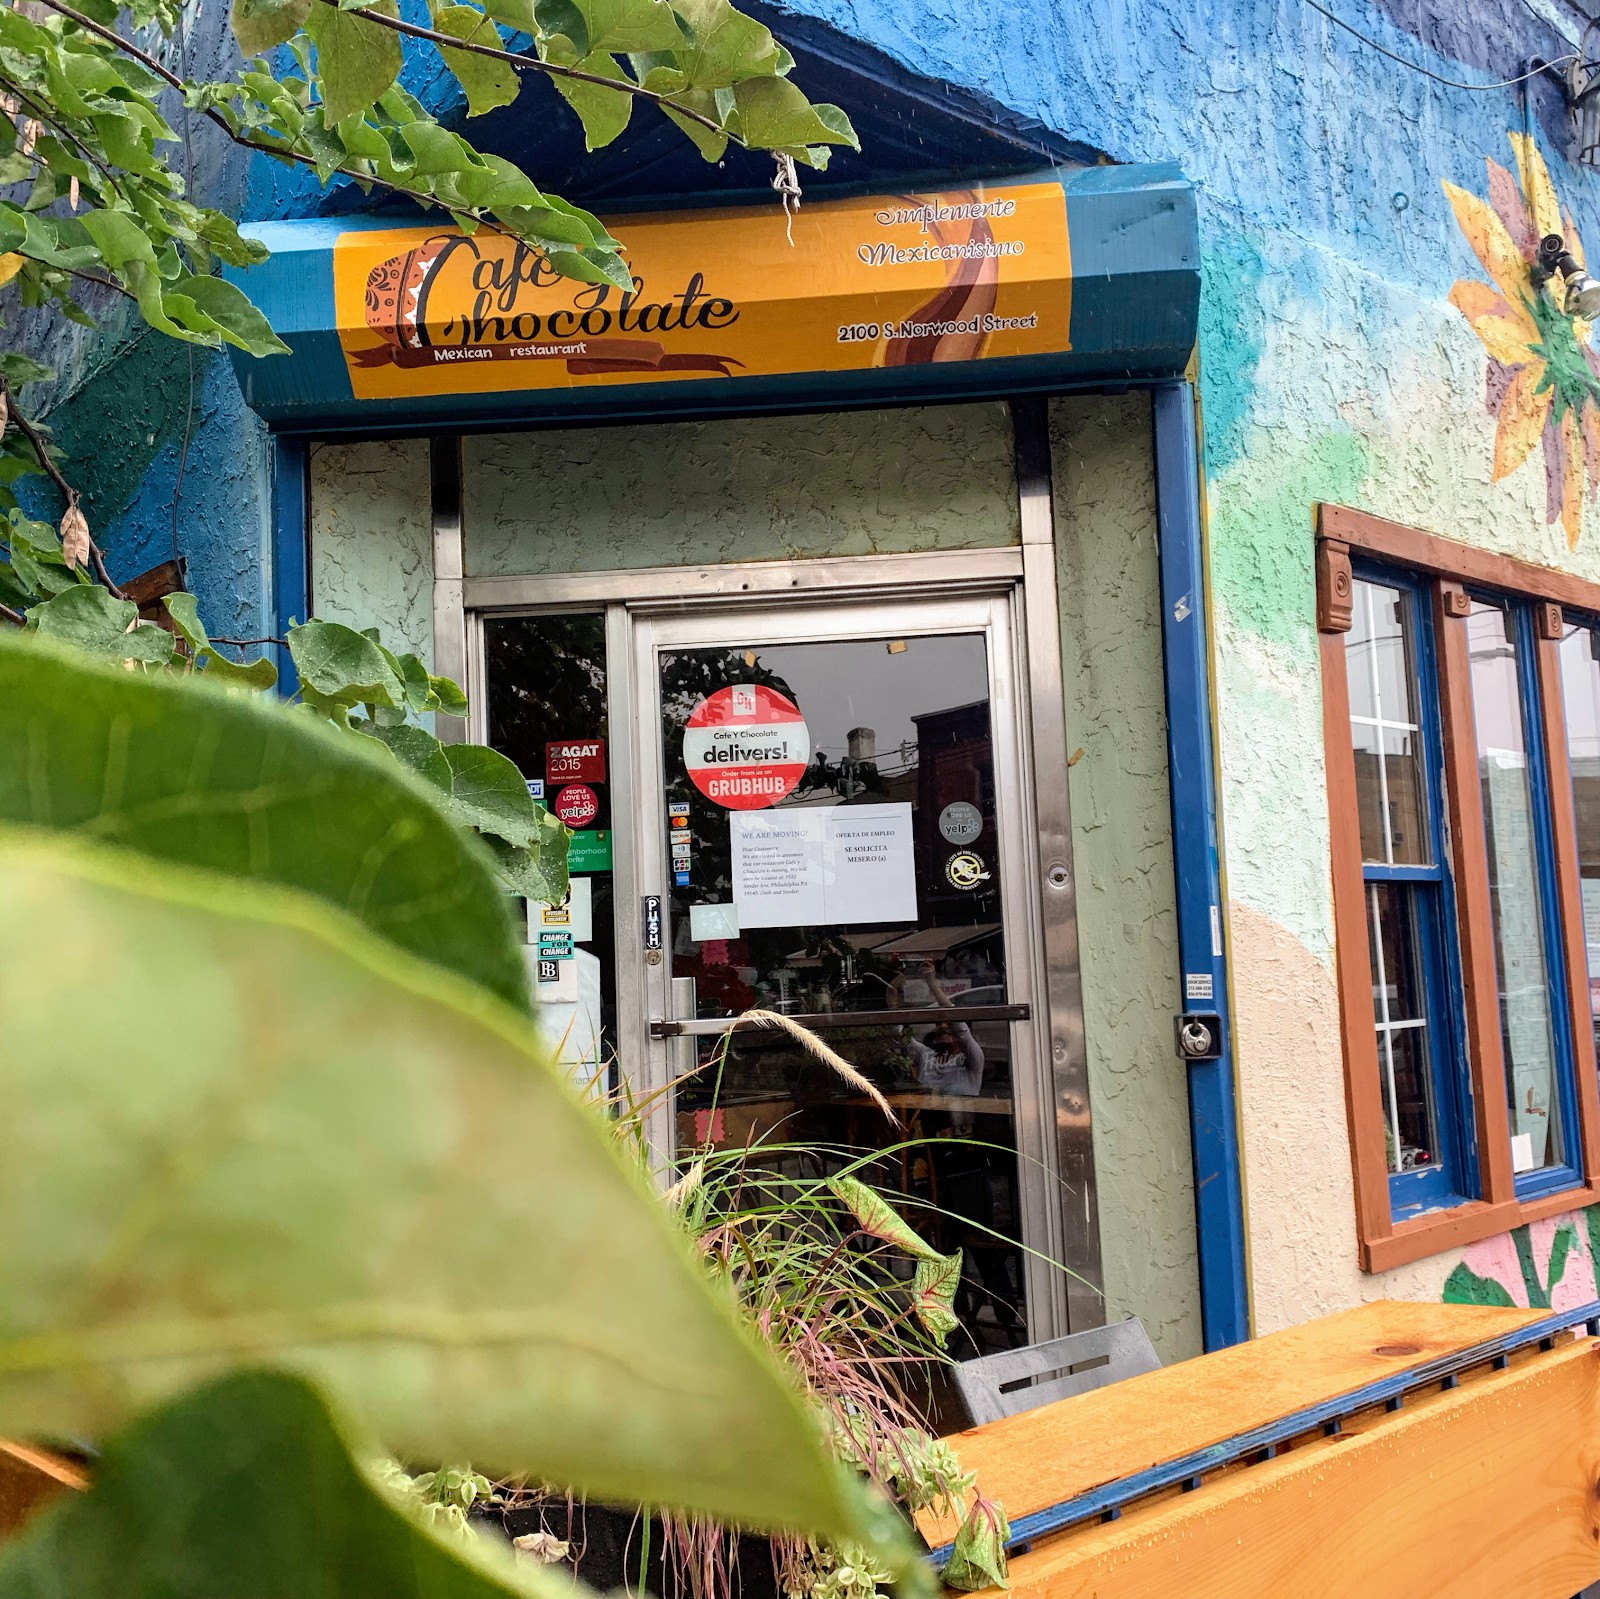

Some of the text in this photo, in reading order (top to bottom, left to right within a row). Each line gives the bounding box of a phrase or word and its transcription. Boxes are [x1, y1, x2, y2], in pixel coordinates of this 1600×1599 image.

[875, 198, 1015, 234] Simplemente
[837, 324, 879, 342] 2100
[983, 311, 1038, 332] Street
[434, 341, 588, 362] Mexican restaurant
[732, 731, 739, 739] Y
[740, 730, 778, 739] Chocolate
[550, 745, 599, 758] ZAGAT
[703, 741, 788, 764] delivers!
[551, 758, 581, 771] 2015
[708, 777, 785, 797] GRUBHUB
[561, 806, 583, 819] yelp
[773, 831, 808, 839] MOVING!
[945, 823, 968, 835] yelp
[569, 848, 607, 856] ghborhood
[647, 899, 659, 946] PUSH
[542, 934, 569, 942] CHANGE
[542, 947, 569, 956] CHANGE
